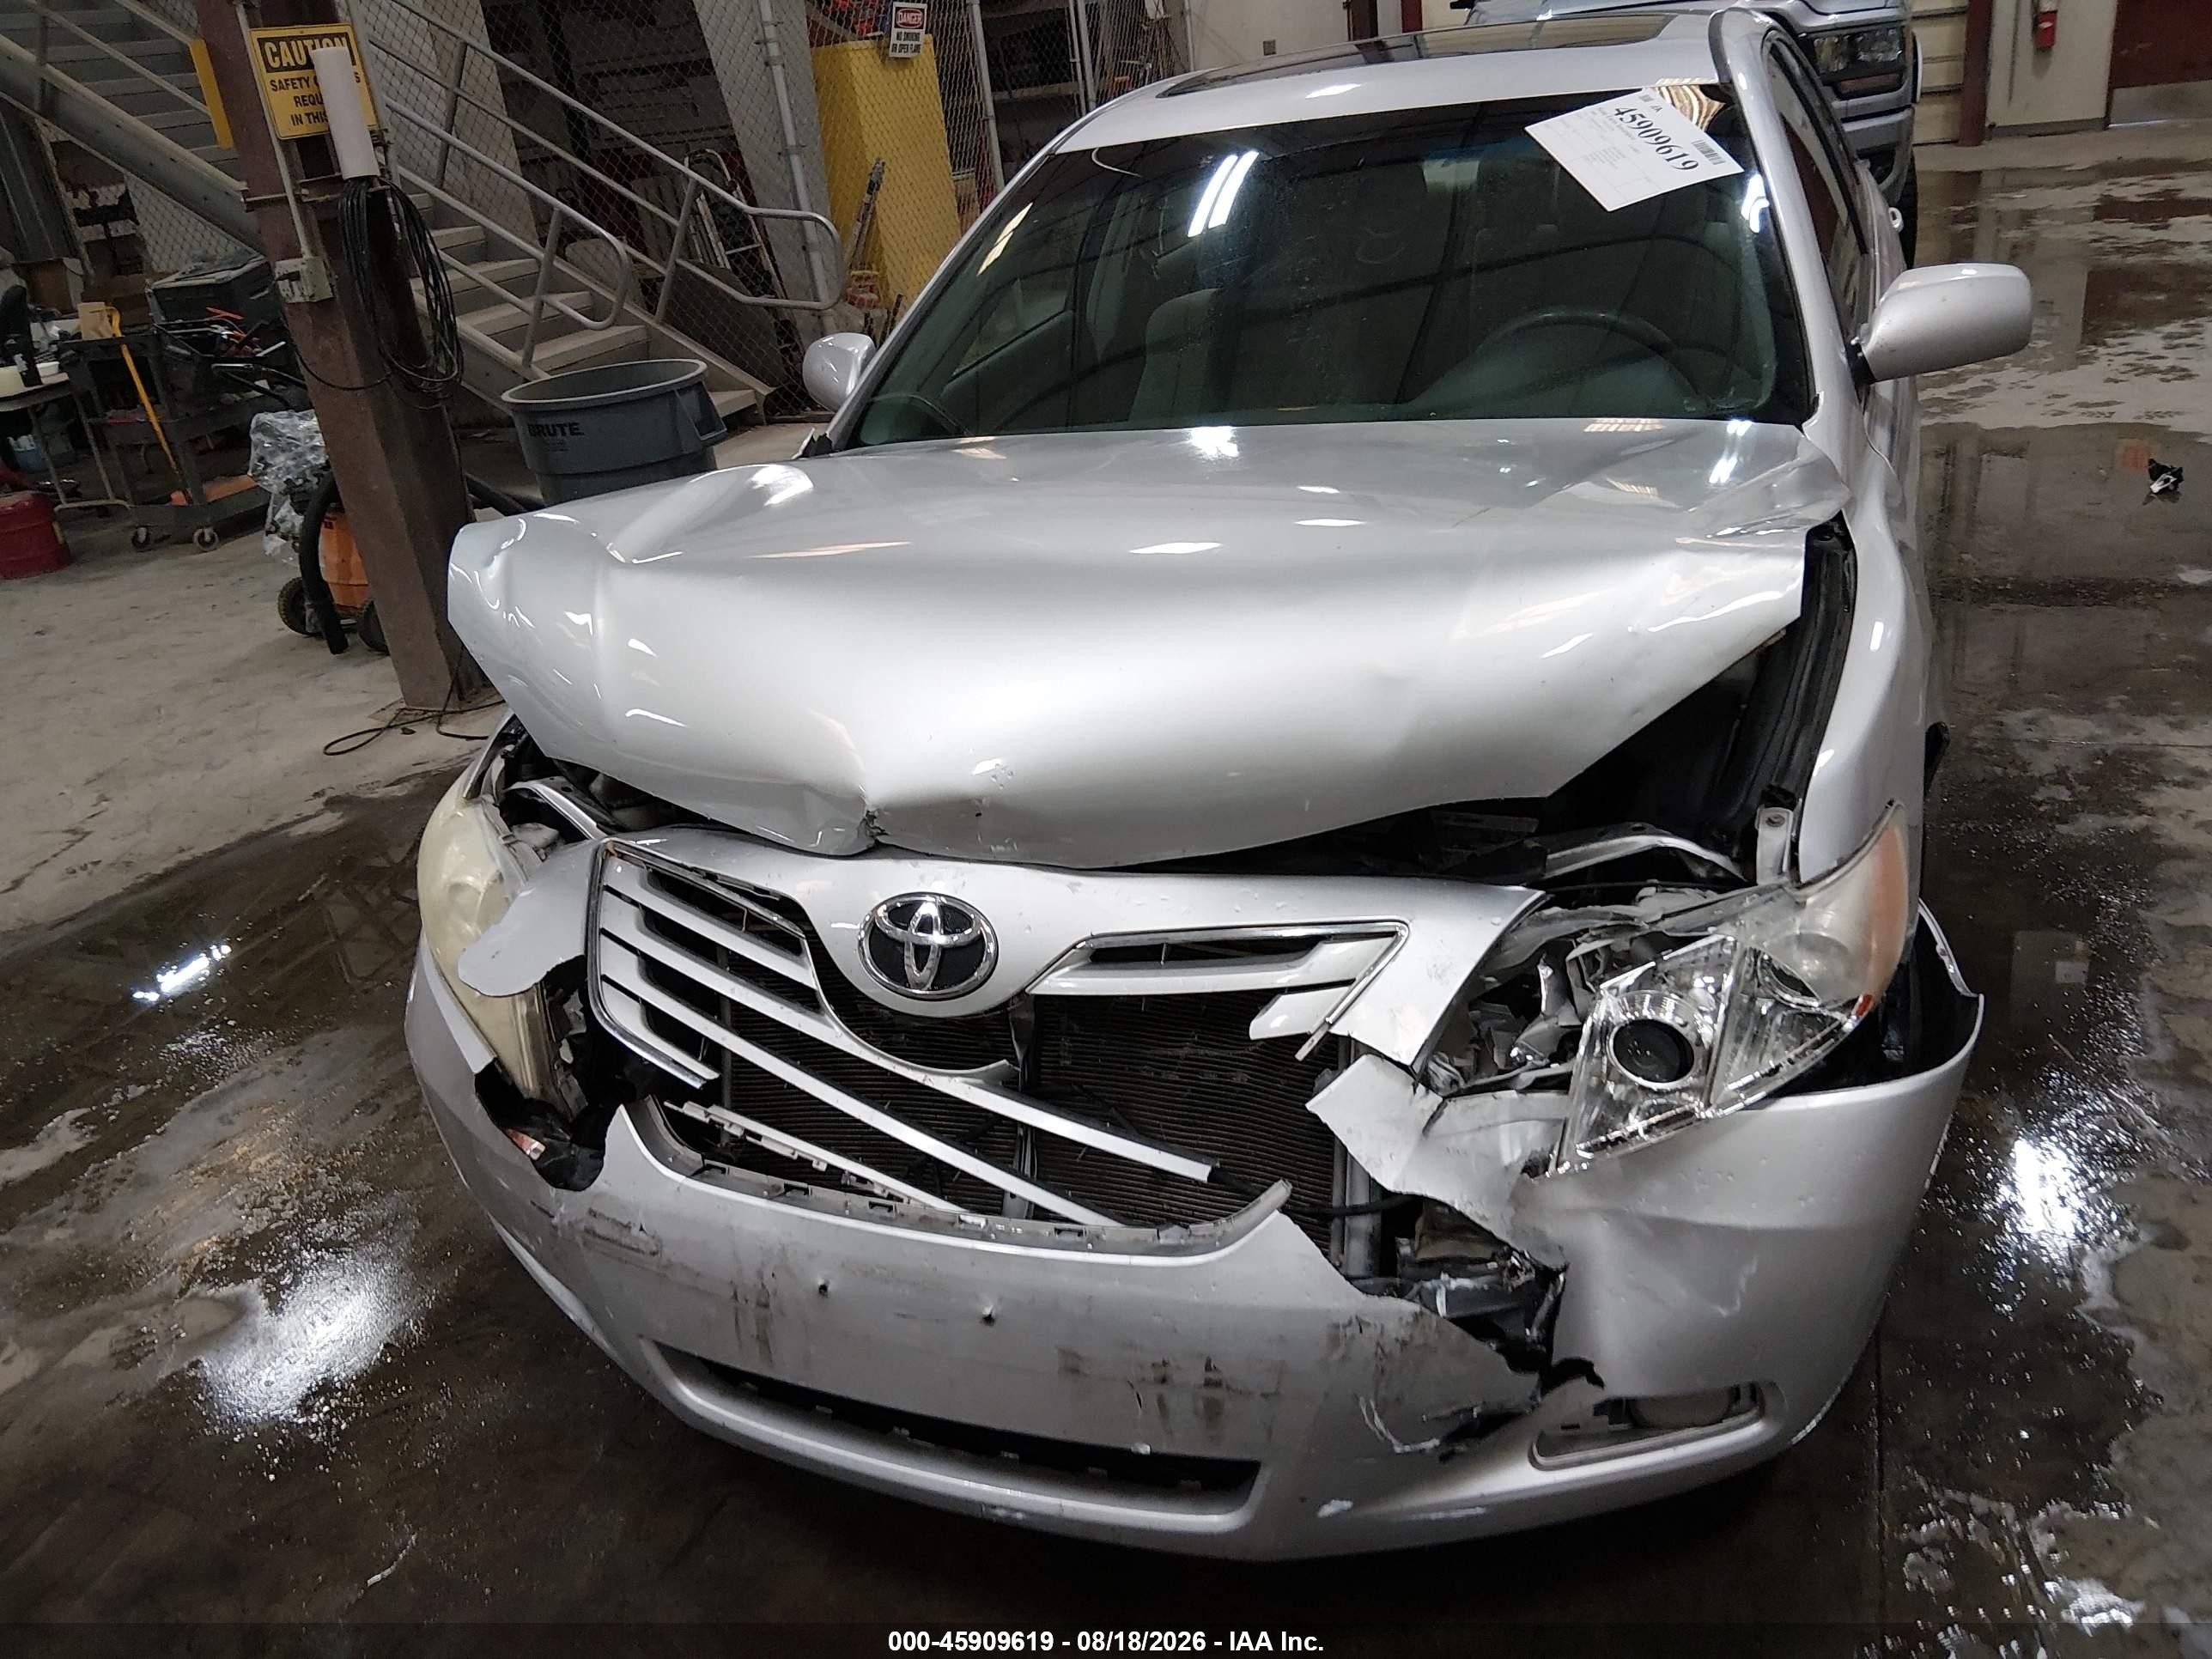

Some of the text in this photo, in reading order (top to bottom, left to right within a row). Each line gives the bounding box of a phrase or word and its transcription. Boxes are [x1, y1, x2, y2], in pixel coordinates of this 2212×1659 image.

[270, 76, 311, 93] SAFETY
[290, 112, 304, 126] IN
[1614, 106, 1699, 171] 45909619
[527, 422, 585, 438] BRUTE
